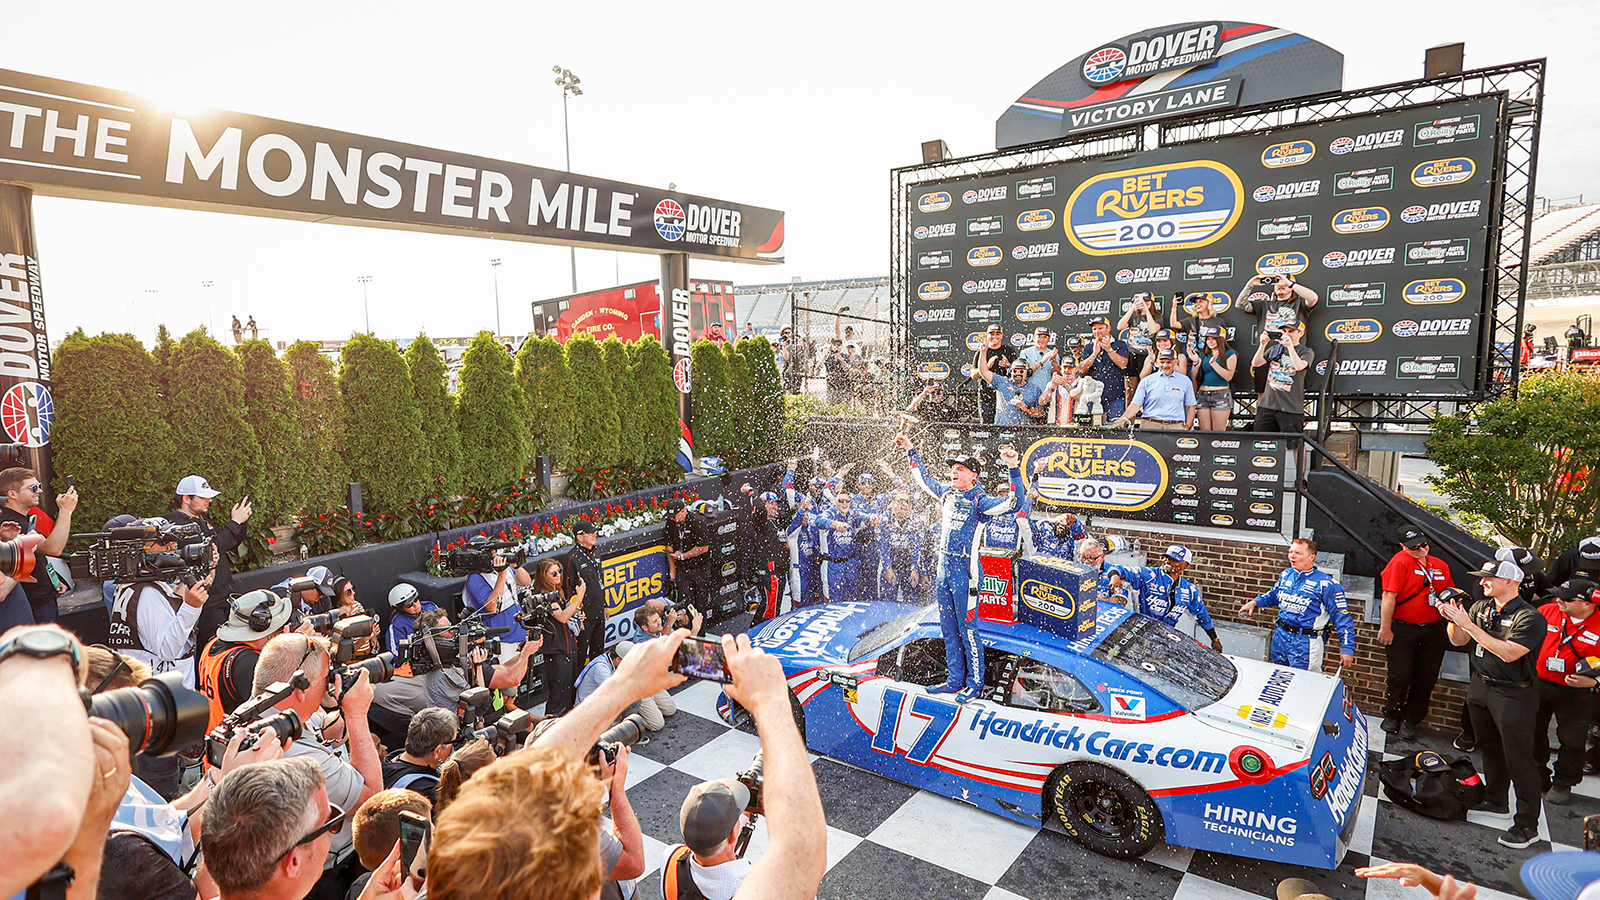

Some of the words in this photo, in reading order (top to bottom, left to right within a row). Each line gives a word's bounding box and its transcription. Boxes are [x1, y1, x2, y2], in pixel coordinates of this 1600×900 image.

[1128, 24, 1219, 66] DOVER
[1125, 62, 1159, 77] MOTOR
[1160, 50, 1213, 69] SPEEDWAY
[1071, 98, 1161, 127] VICTORY
[1165, 85, 1228, 110] LANE
[1458, 122, 1475, 130] AUTO
[1355, 129, 1404, 147] DOVER
[1272, 146, 1305, 157] RIVERS
[1353, 144, 1372, 153] MOTOR
[0, 102, 131, 163] THE
[165, 117, 514, 223] MONSTER
[527, 178, 634, 237] MILE
[1423, 163, 1463, 175] RIVERS
[1122, 173, 1168, 193] BET
[1277, 180, 1321, 196] DOVER
[978, 186, 1007, 199] DOVER
[1096, 186, 1205, 218] RIVERS
[1428, 200, 1482, 216] DOVER
[686, 203, 742, 238] DOVER
[1343, 212, 1379, 222] RIVERS
[1426, 214, 1448, 222] MOTOR
[928, 223, 957, 234] DOVER
[1119, 221, 1176, 241] 200
[1350, 222, 1370, 230] 200
[685, 232, 708, 245] MOTOR
[709, 235, 740, 248] SPEEDWAY
[1029, 242, 1060, 255] DOVER
[1348, 247, 1396, 262] DOVER
[1266, 258, 1299, 267] RIVERS
[1134, 266, 1172, 279] DOVER
[977, 279, 1007, 290] DOVER
[1414, 283, 1453, 294] RIVERS
[27, 255, 46, 333] SPEEDWAY
[928, 309, 955, 319] DOVER
[1078, 300, 1111, 312] DOVER
[0, 253, 39, 379] DOVER
[571, 309, 594, 329] CAMDEN
[599, 307, 629, 321] WYOMING
[672, 287, 690, 357] DOVER
[586, 324, 601, 333] FIRE
[602, 323, 615, 331] CO.
[1336, 323, 1371, 333] RIVERS
[1420, 319, 1472, 331] DOVER
[38, 333, 51, 382] MOTOR
[1340, 359, 1387, 371] DOVER
[1069, 444, 1106, 458] BET
[1048, 451, 1137, 478] RIVERS
[1067, 483, 1113, 499] 200
[603, 561, 637, 587] BET
[981, 576, 1006, 594] eilly
[1039, 584, 1054, 594] BET
[605, 572, 663, 615] IVERS
[979, 595, 1008, 606] PARTS
[1030, 586, 1065, 605] RIVERS
[1038, 601, 1056, 612] 200
[1097, 606, 1128, 626] TECHS
[605, 617, 637, 643] 20
[981, 639, 997, 647] AY
[1258, 685, 1287, 707] AUTO
[1114, 710, 1142, 718] Valvoline
[871, 685, 963, 767] 17
[1054, 774, 1079, 837] GOODYEAR
[1137, 806, 1150, 841] EAGLE
[1204, 802, 1298, 834] HIRING
[1203, 820, 1295, 847] TECHNICIANS
